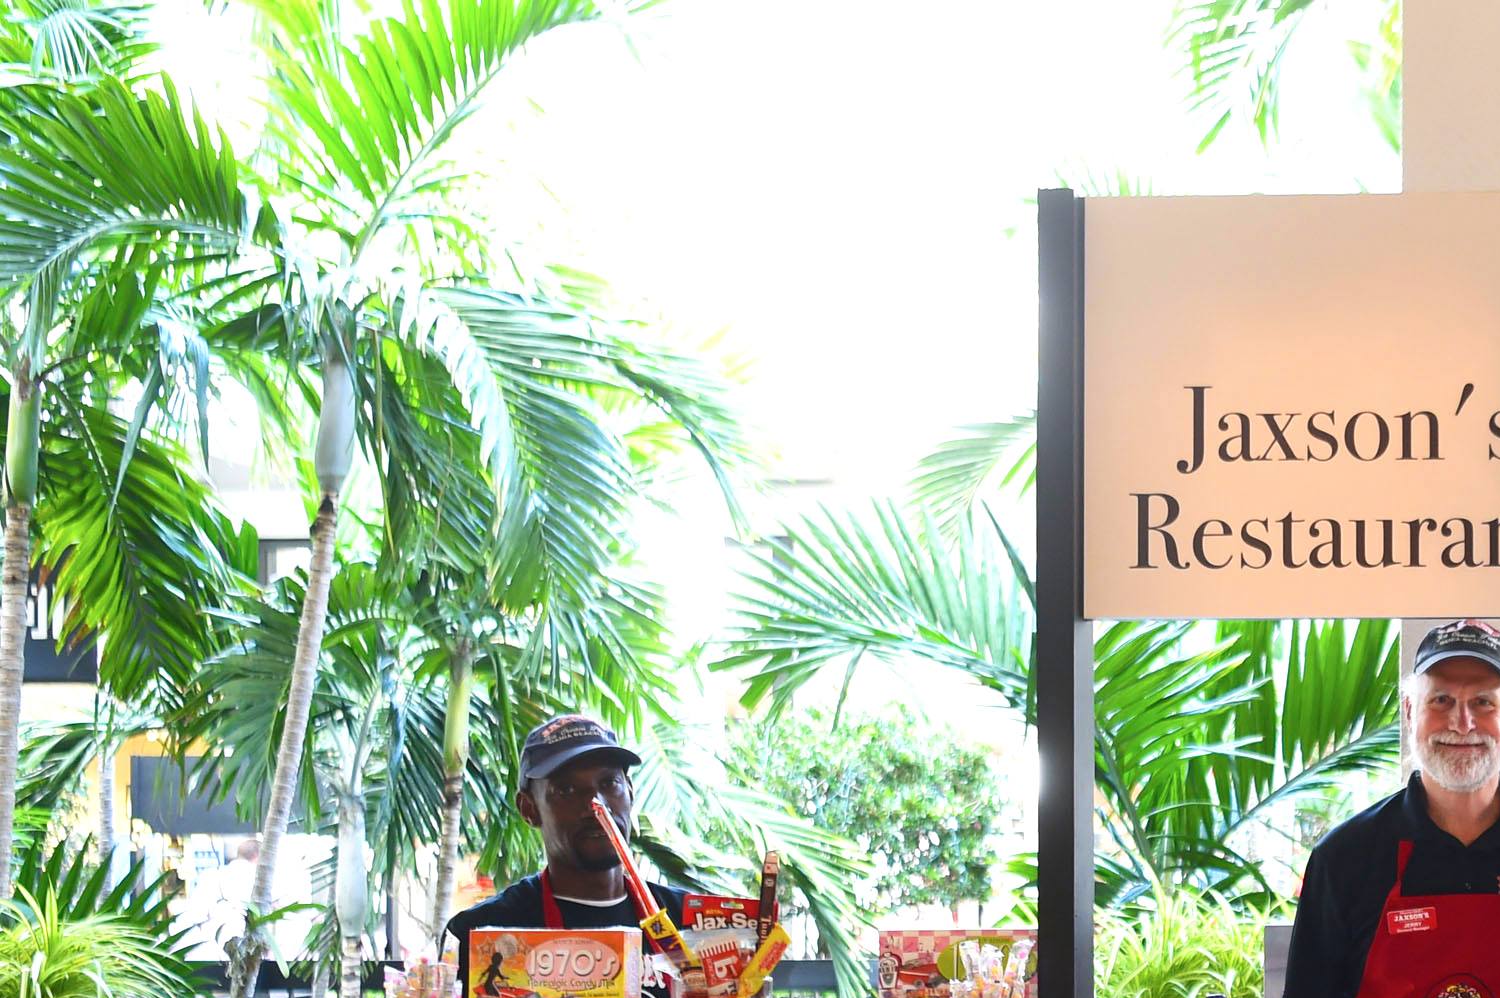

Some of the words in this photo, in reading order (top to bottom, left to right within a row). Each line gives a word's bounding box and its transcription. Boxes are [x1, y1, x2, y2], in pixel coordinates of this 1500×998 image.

[691, 912, 727, 932] Jax
[1393, 911, 1431, 923] JAXSON'S
[527, 948, 617, 977] 1970's
